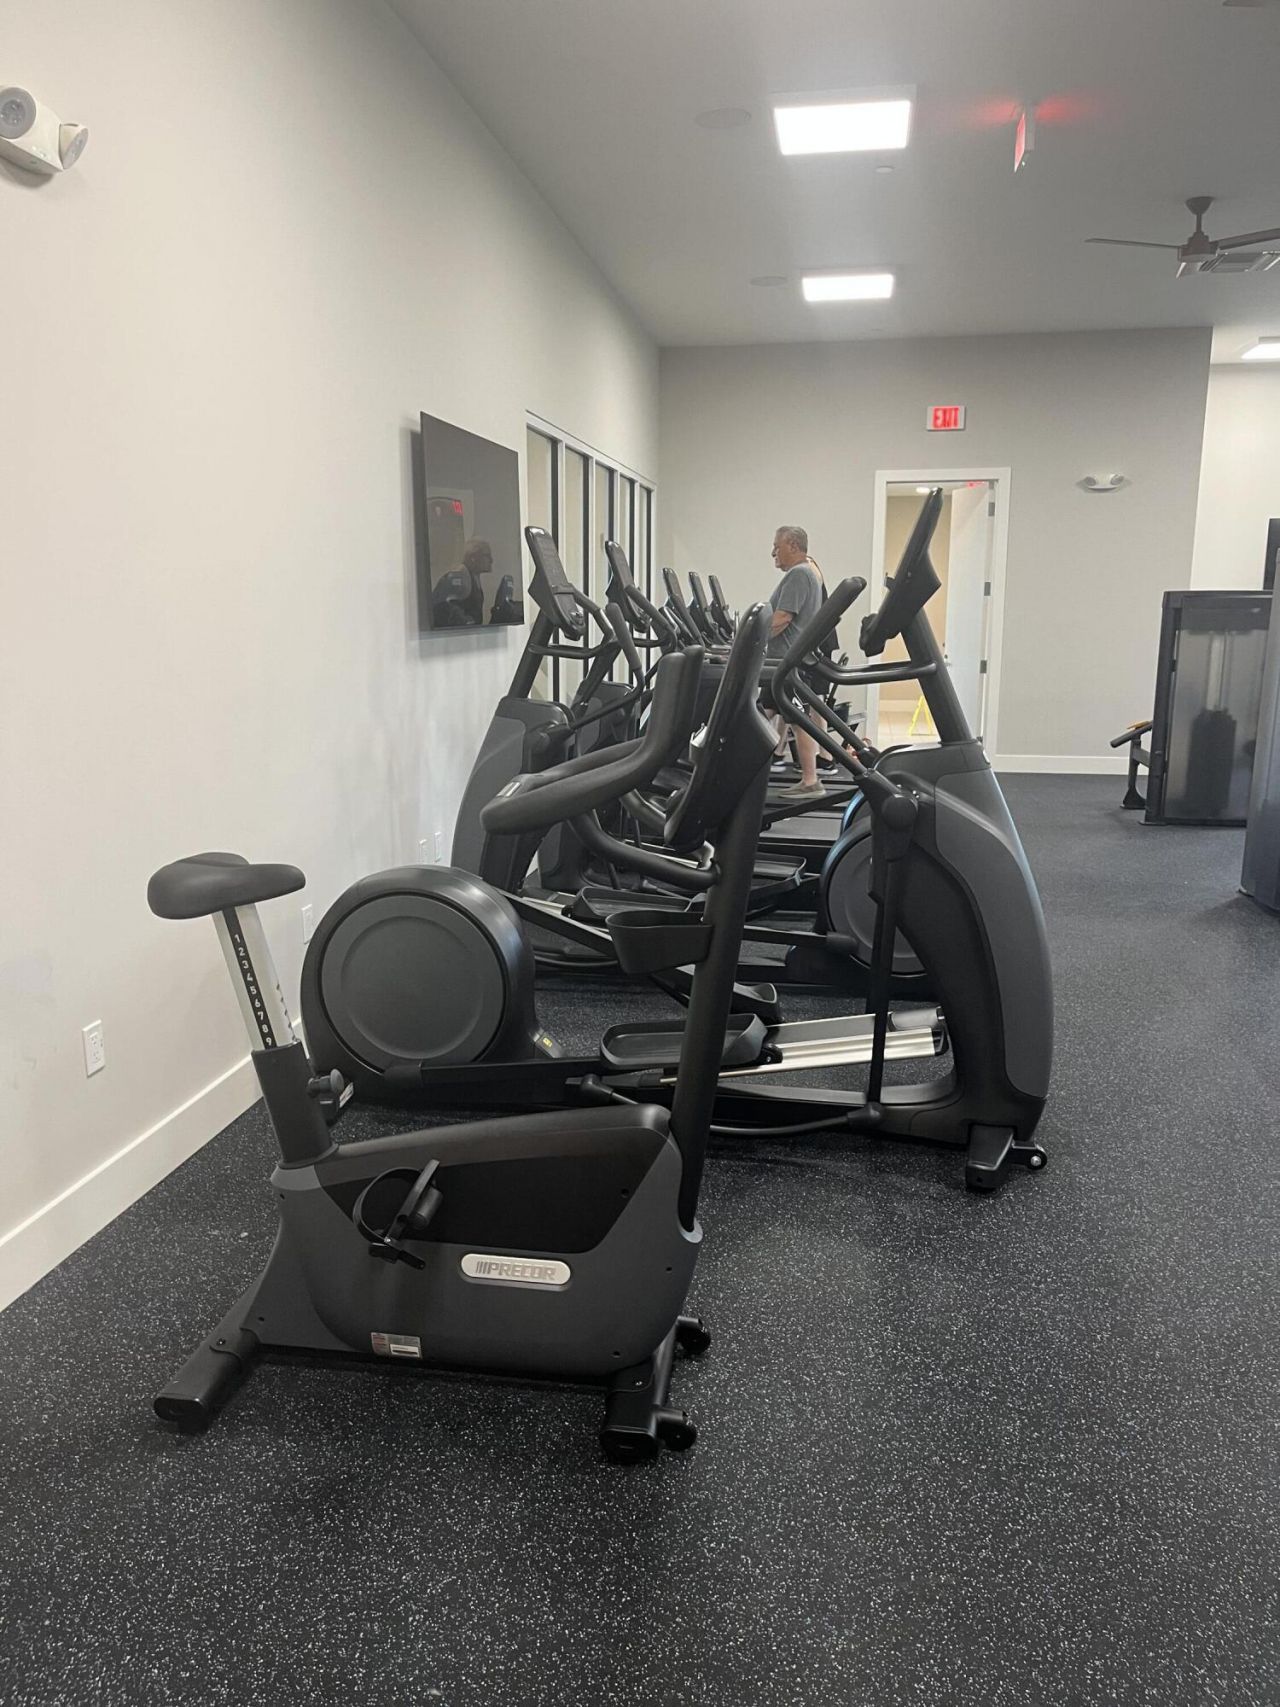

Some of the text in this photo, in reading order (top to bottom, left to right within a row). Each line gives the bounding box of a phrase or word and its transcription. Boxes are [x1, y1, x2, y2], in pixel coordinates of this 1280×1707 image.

[933, 407, 959, 428] EXIT
[234, 934, 272, 1046] 1 2 3 4 5 6 7 8 9
[486, 1261, 557, 1280] PRECOR
